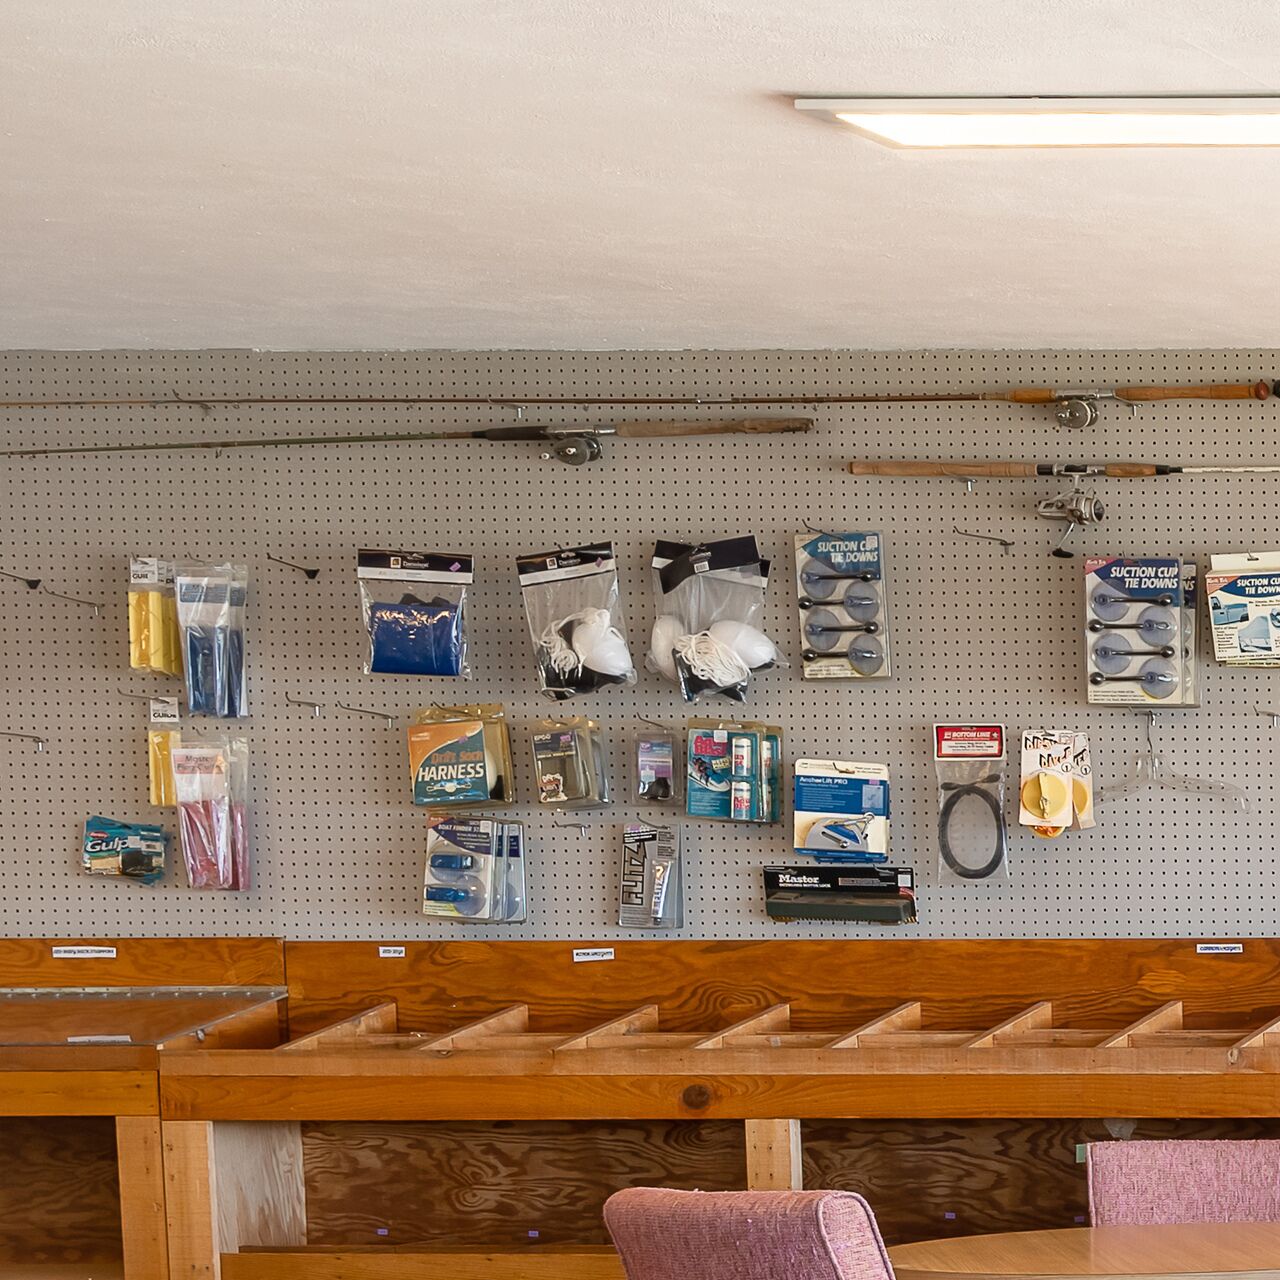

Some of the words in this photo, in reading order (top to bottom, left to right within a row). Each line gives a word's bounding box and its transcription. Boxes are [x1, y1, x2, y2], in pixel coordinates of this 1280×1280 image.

[817, 541, 858, 552] SUCTION
[831, 552, 844, 563] TIE
[845, 552, 878, 562] DOWNS
[1110, 566, 1156, 578] SUCTION
[1157, 566, 1179, 578] CUP
[1124, 578, 1139, 588] TIE
[1141, 578, 1178, 589] DOWNS
[1236, 578, 1268, 587] SUCTION
[1245, 586, 1256, 595] TIE
[418, 763, 484, 782] HARNESS
[622, 841, 648, 906] FLITZ
